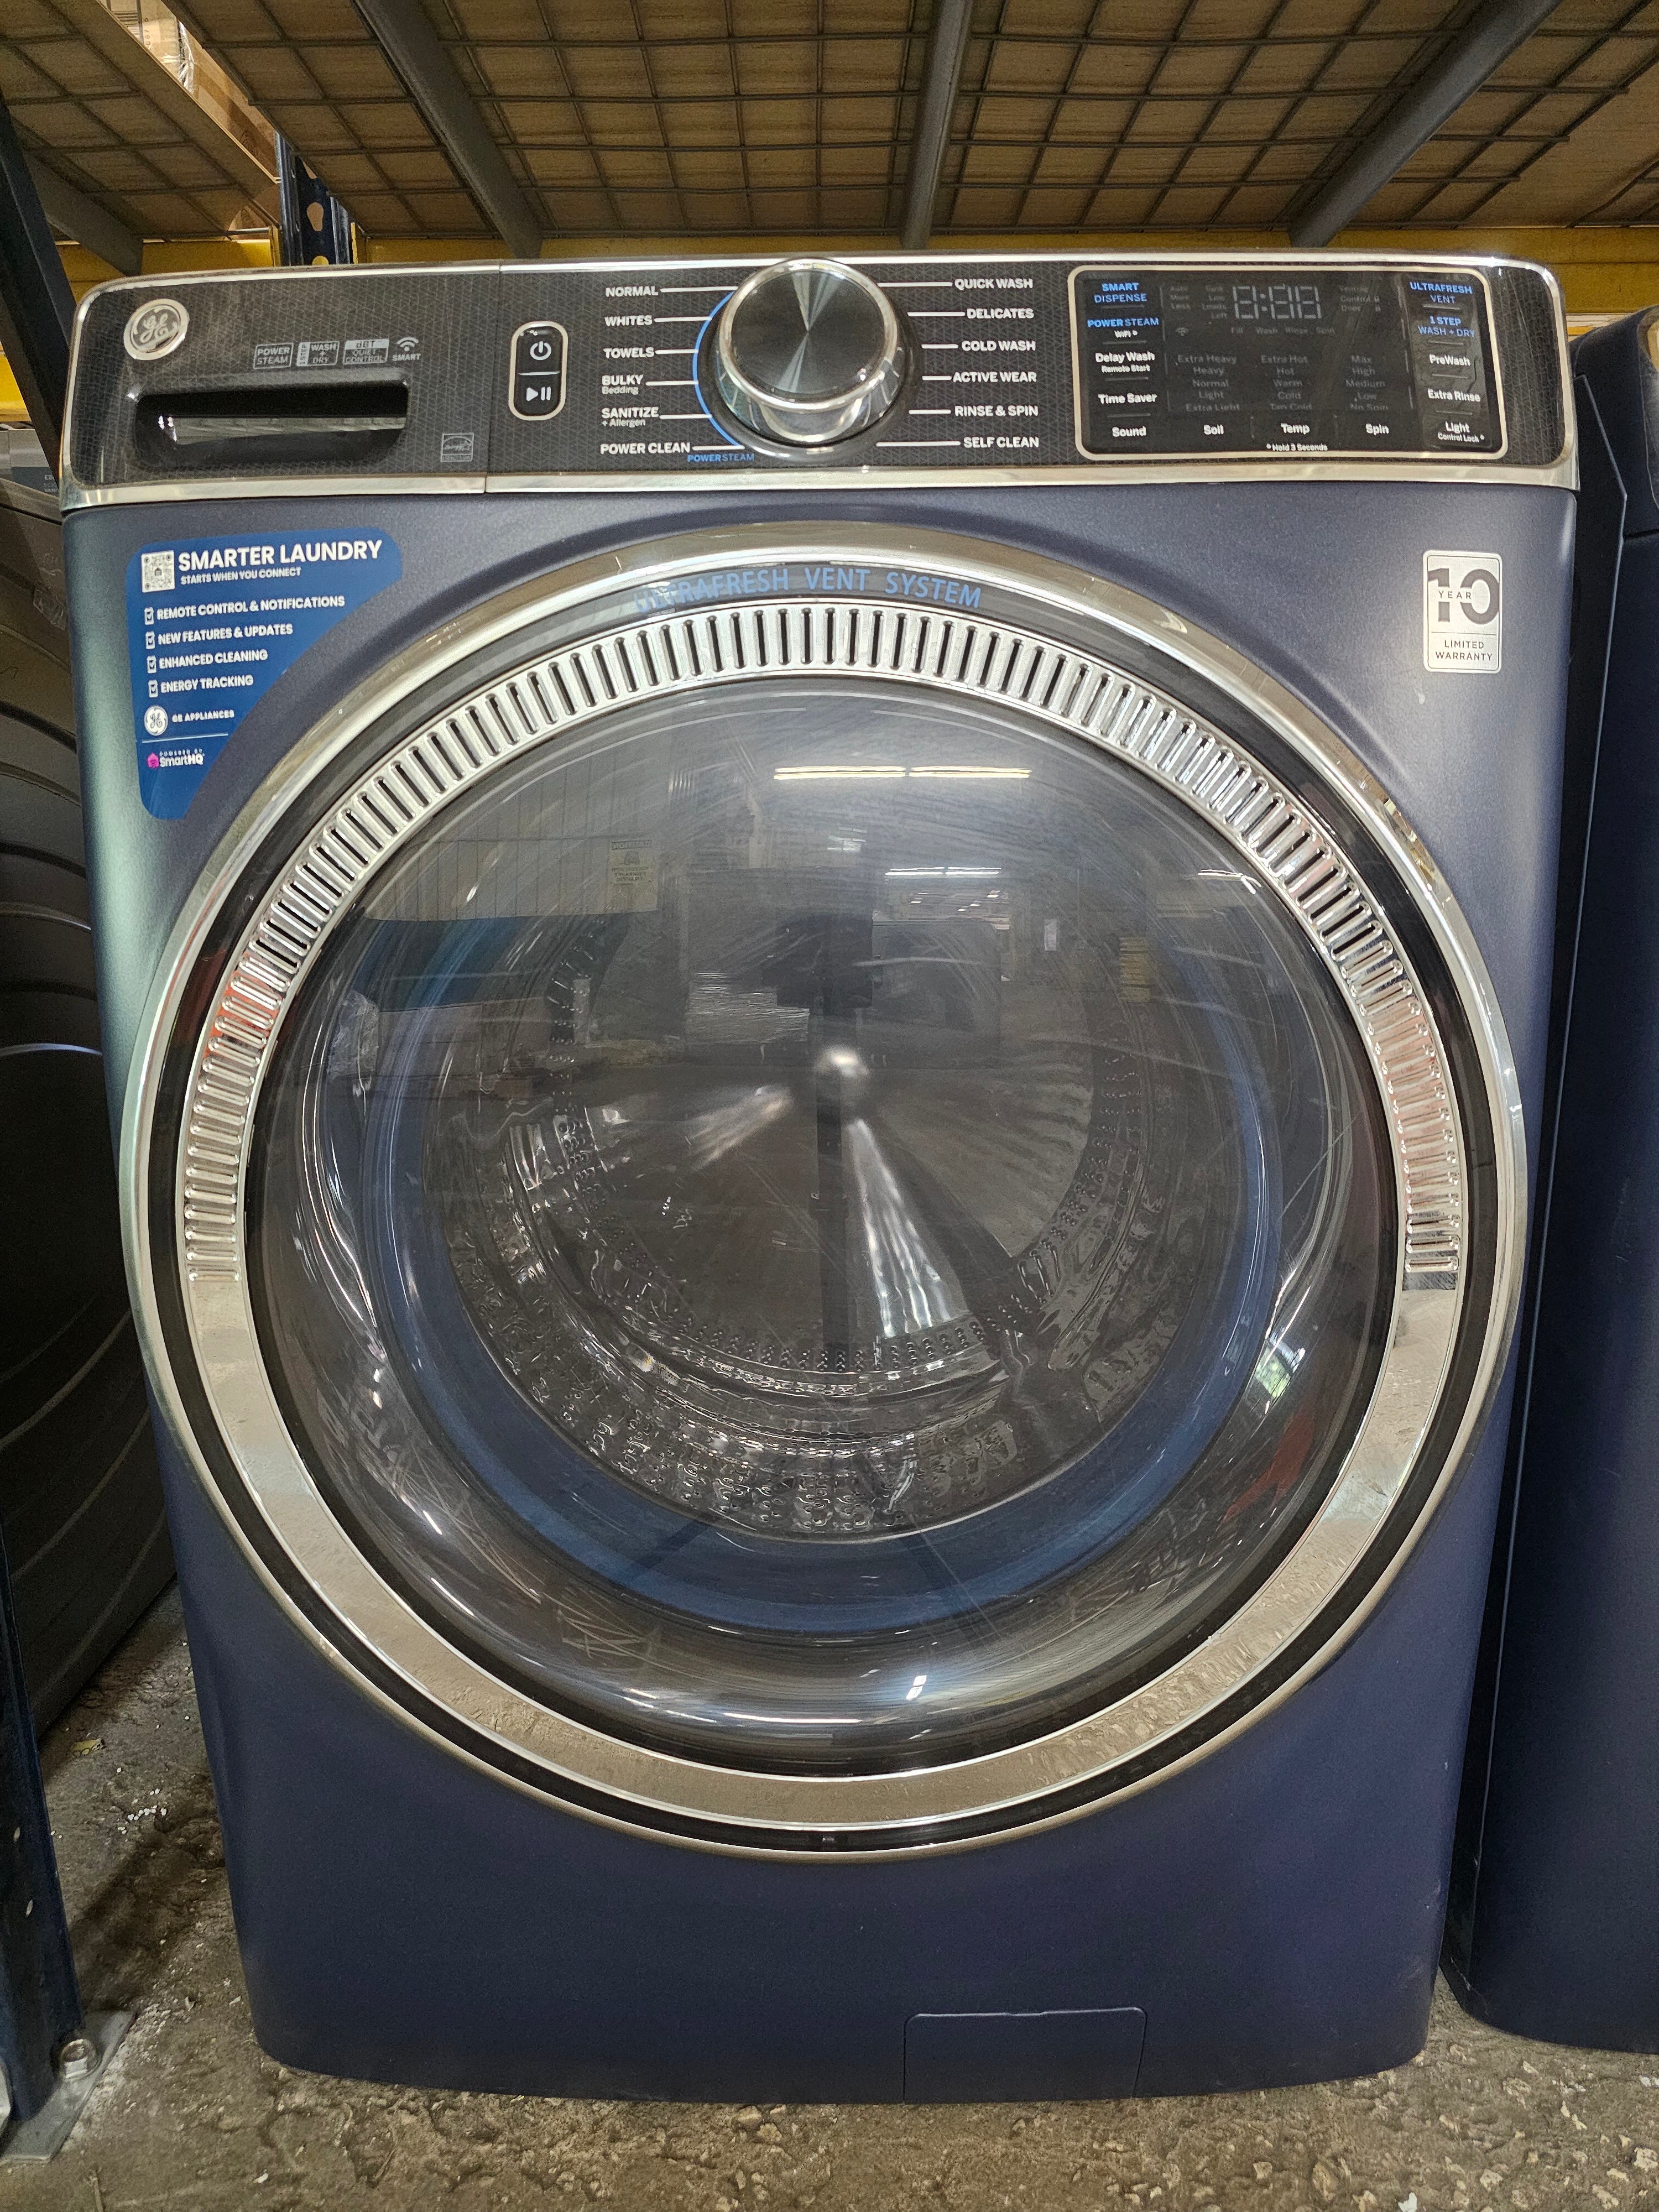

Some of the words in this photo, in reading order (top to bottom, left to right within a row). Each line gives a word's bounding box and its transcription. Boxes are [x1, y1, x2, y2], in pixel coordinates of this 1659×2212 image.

[954, 279, 994, 291] QUICK
[997, 278, 1033, 289] WASH
[1102, 283, 1139, 291] SMART
[1410, 281, 1473, 295] ULTRAFRESH
[605, 286, 659, 297] NORMAL
[1094, 293, 1147, 303] DISPENSE
[1430, 294, 1455, 304] VENT
[967, 308, 1035, 319] DELICATES
[604, 315, 653, 327] WHITES
[1430, 316, 1436, 324] 1
[1437, 316, 1462, 326] STEP
[1417, 326, 1447, 337] WASH
[1457, 328, 1475, 338] DRY
[257, 346, 290, 356] POWER
[311, 342, 337, 351] WASH
[961, 341, 996, 351] COLD
[998, 340, 1036, 351] WASH
[392, 352, 421, 362] SMART
[603, 347, 654, 358] TOWELS
[1095, 352, 1125, 364] Delay
[1125, 351, 1155, 362] Wash
[257, 356, 288, 366] STEAM
[1429, 353, 1471, 367] PreWash
[1101, 365, 1130, 373] Remote
[1131, 363, 1151, 372] Start
[602, 374, 643, 386] BULKY
[953, 372, 998, 383] ACTIVE
[1000, 372, 1037, 382] WEAR
[602, 385, 639, 395] Bedding
[1427, 388, 1453, 400] Extra
[1454, 389, 1481, 403] Rinse
[1098, 393, 1125, 404] Time
[1126, 393, 1157, 404] Saver
[601, 407, 659, 419] SANITIZE
[954, 405, 994, 416] RINSE
[995, 405, 1006, 416] &
[1008, 405, 1039, 416] SPIN
[609, 418, 646, 429] Allergen
[1280, 422, 1311, 435] Temp
[1445, 421, 1470, 434] Light
[1112, 426, 1147, 437] Sound
[1203, 424, 1224, 435] Soil
[1365, 423, 1390, 436] Spin
[963, 437, 994, 448] SELF
[996, 437, 1039, 448] CLEAN
[1437, 432, 1463, 441] Control
[1463, 434, 1479, 442] Lock
[601, 443, 646, 455] POWER
[648, 442, 690, 453] CLEAN
[1297, 443, 1328, 451] Seconds
[178, 545, 274, 571] SMARTER
[279, 539, 383, 564] LAUNDRY
[180, 574, 211, 585] STARTS
[212, 571, 238, 582] WHEN
[239, 569, 258, 580] YOU
[258, 566, 302, 578] CONNECT
[633, 567, 789, 613] ULTRAFRESH
[804, 567, 871, 591] VENT
[885, 571, 981, 609] SYSTEM
[1438, 591, 1472, 599] YEAR
[1427, 567, 1499, 625] 10
[156, 606, 197, 620] REMOTE
[198, 601, 248, 617] CONTROL
[250, 601, 259, 612] &
[260, 596, 345, 611] NOTIFICATIONS
[158, 632, 181, 645] NEW
[182, 627, 232, 643] FEATURES
[233, 627, 243, 638] &
[244, 623, 293, 637] UPDATES
[1444, 639, 1484, 649] LIMITED
[159, 654, 212, 669] ENHANCED
[215, 649, 268, 665] CLEANING
[1435, 651, 1493, 661] WARRANTY
[160, 679, 198, 693] ENERGY
[200, 675, 254, 690] TRACKING
[171, 713, 183, 723] GE
[184, 709, 235, 722] APPLIANCES
[159, 753, 204, 768] SmartHQ
